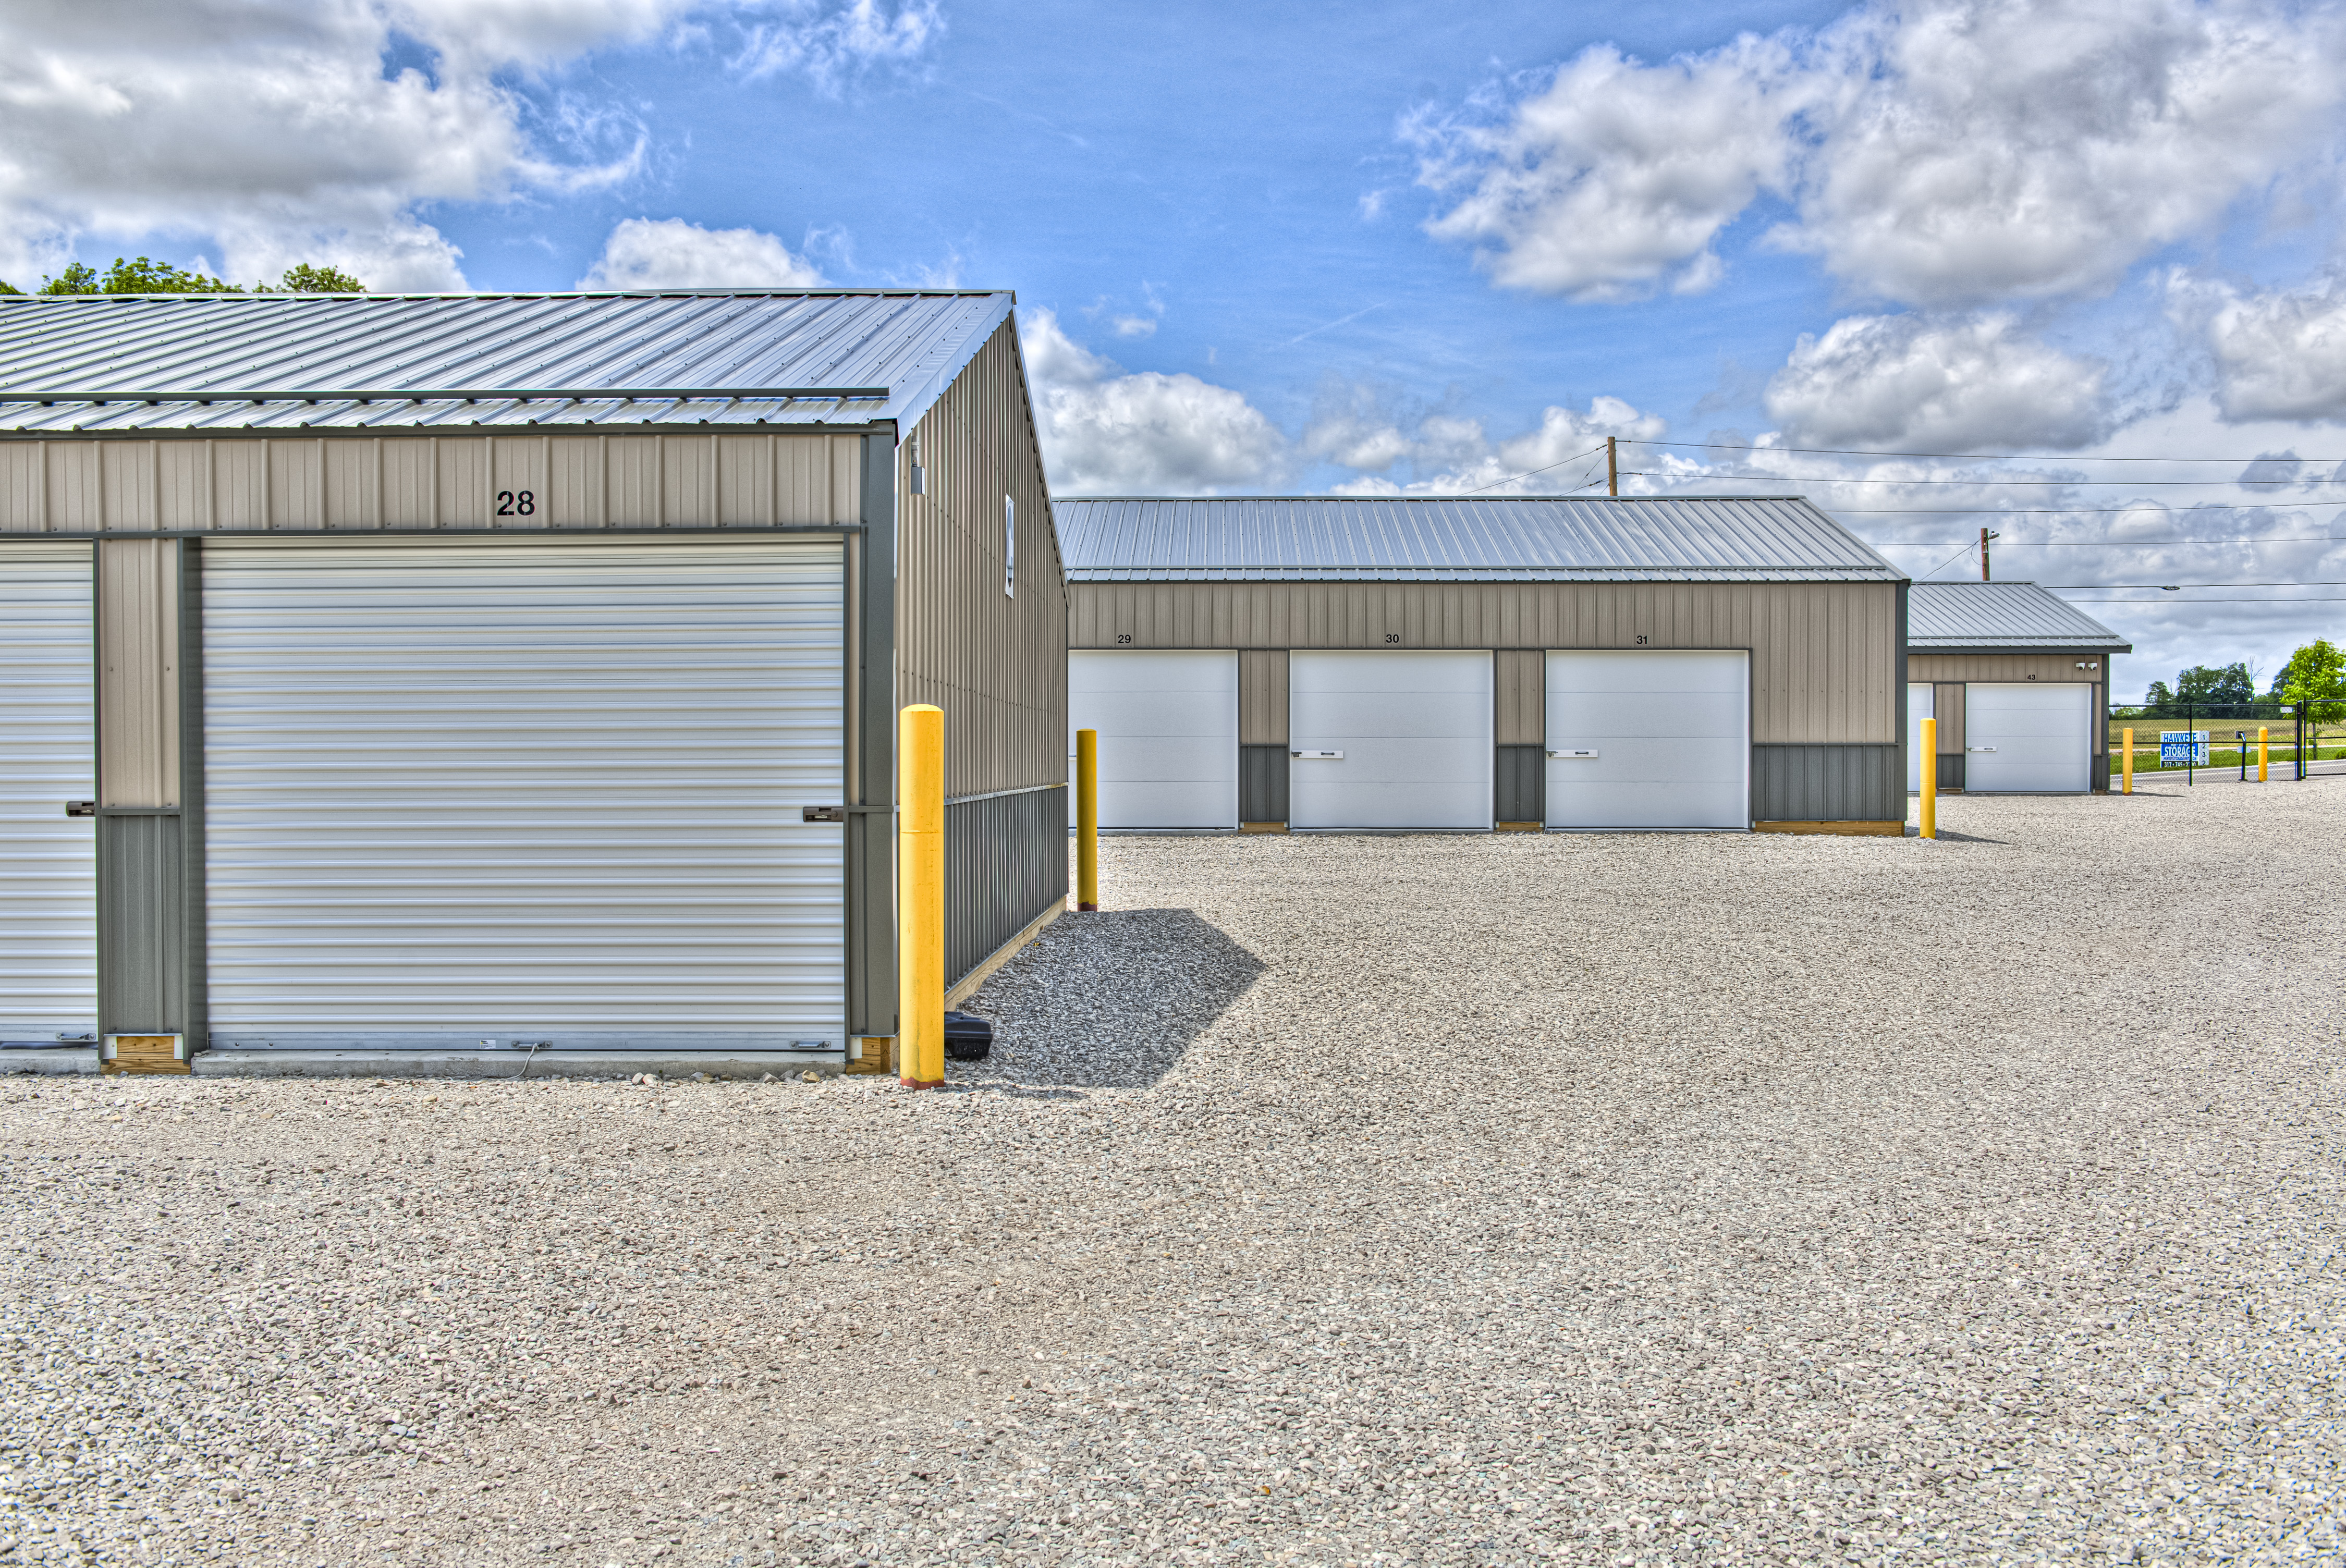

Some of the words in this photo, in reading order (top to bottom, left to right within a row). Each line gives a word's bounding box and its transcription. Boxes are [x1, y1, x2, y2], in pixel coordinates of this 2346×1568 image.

[497, 490, 535, 516] 28
[1118, 634, 1131, 644] 29
[1386, 634, 1399, 643] 30
[1636, 635, 1648, 644] 31
[2164, 733, 2196, 742] HAWKEE
[2165, 746, 2195, 756] STORAGE
